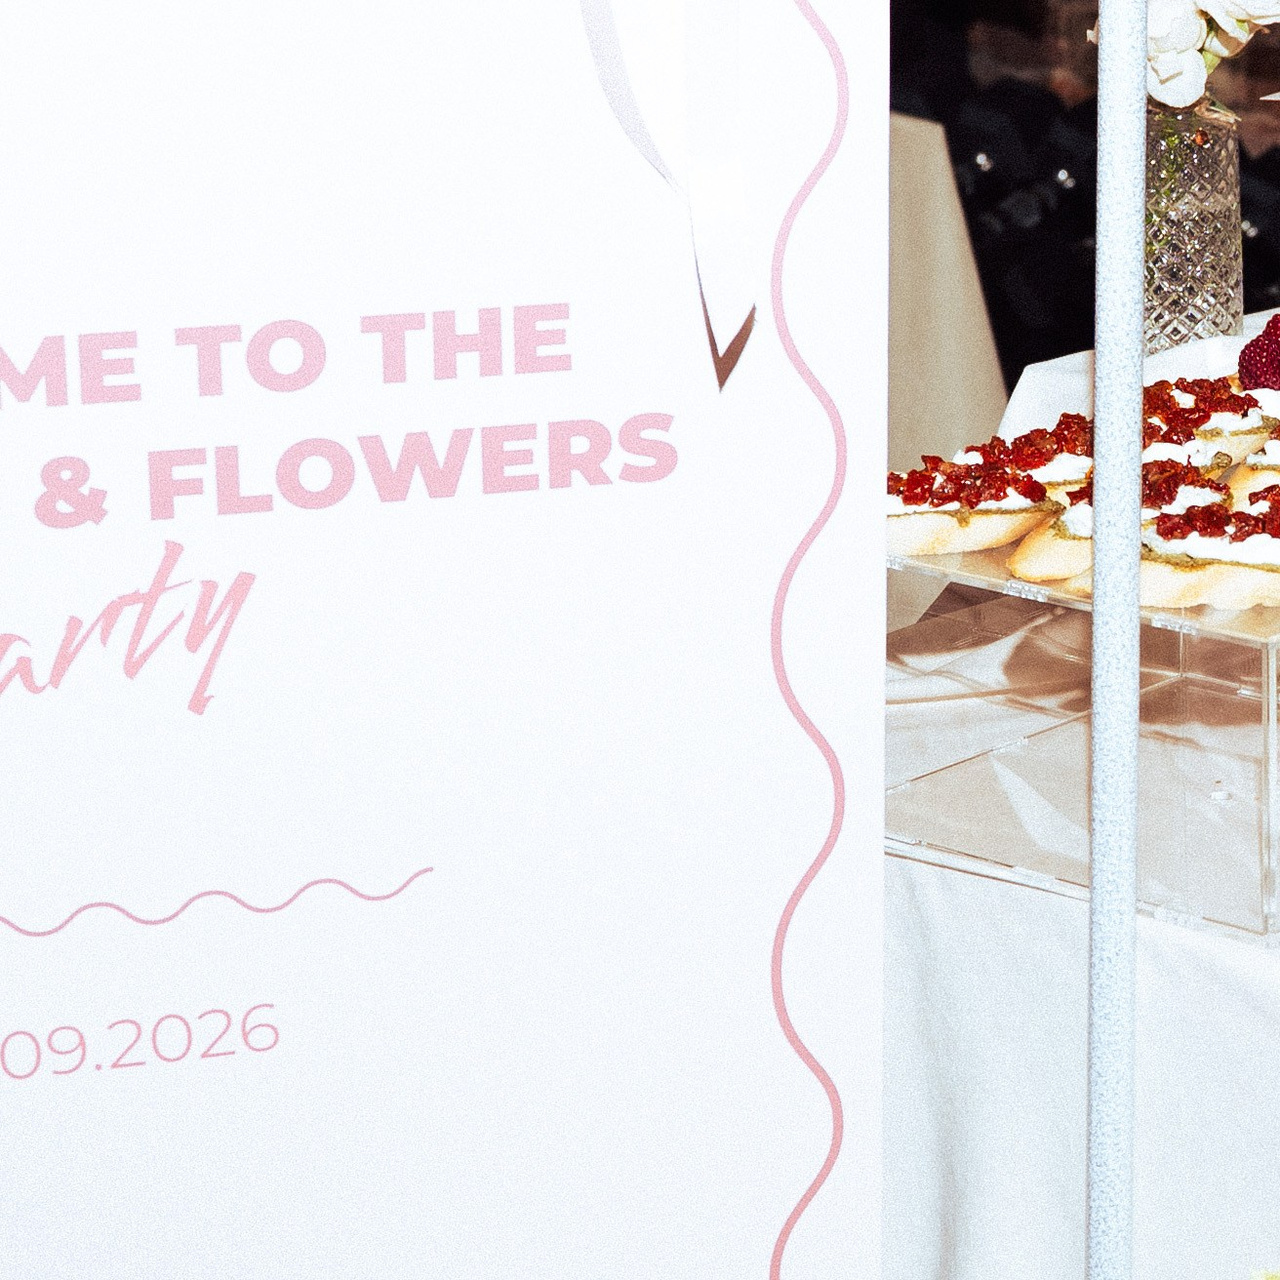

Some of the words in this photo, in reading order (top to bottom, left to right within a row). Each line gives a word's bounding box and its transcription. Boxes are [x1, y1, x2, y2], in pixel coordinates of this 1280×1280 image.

[0, 330, 142, 408] ME
[174, 319, 327, 396] TO
[360, 302, 573, 385] THE
[34, 455, 109, 530] &
[147, 412, 679, 522] FLOWERS
[0, 539, 257, 716] arty
[0, 1002, 280, 1081] 09.2026
